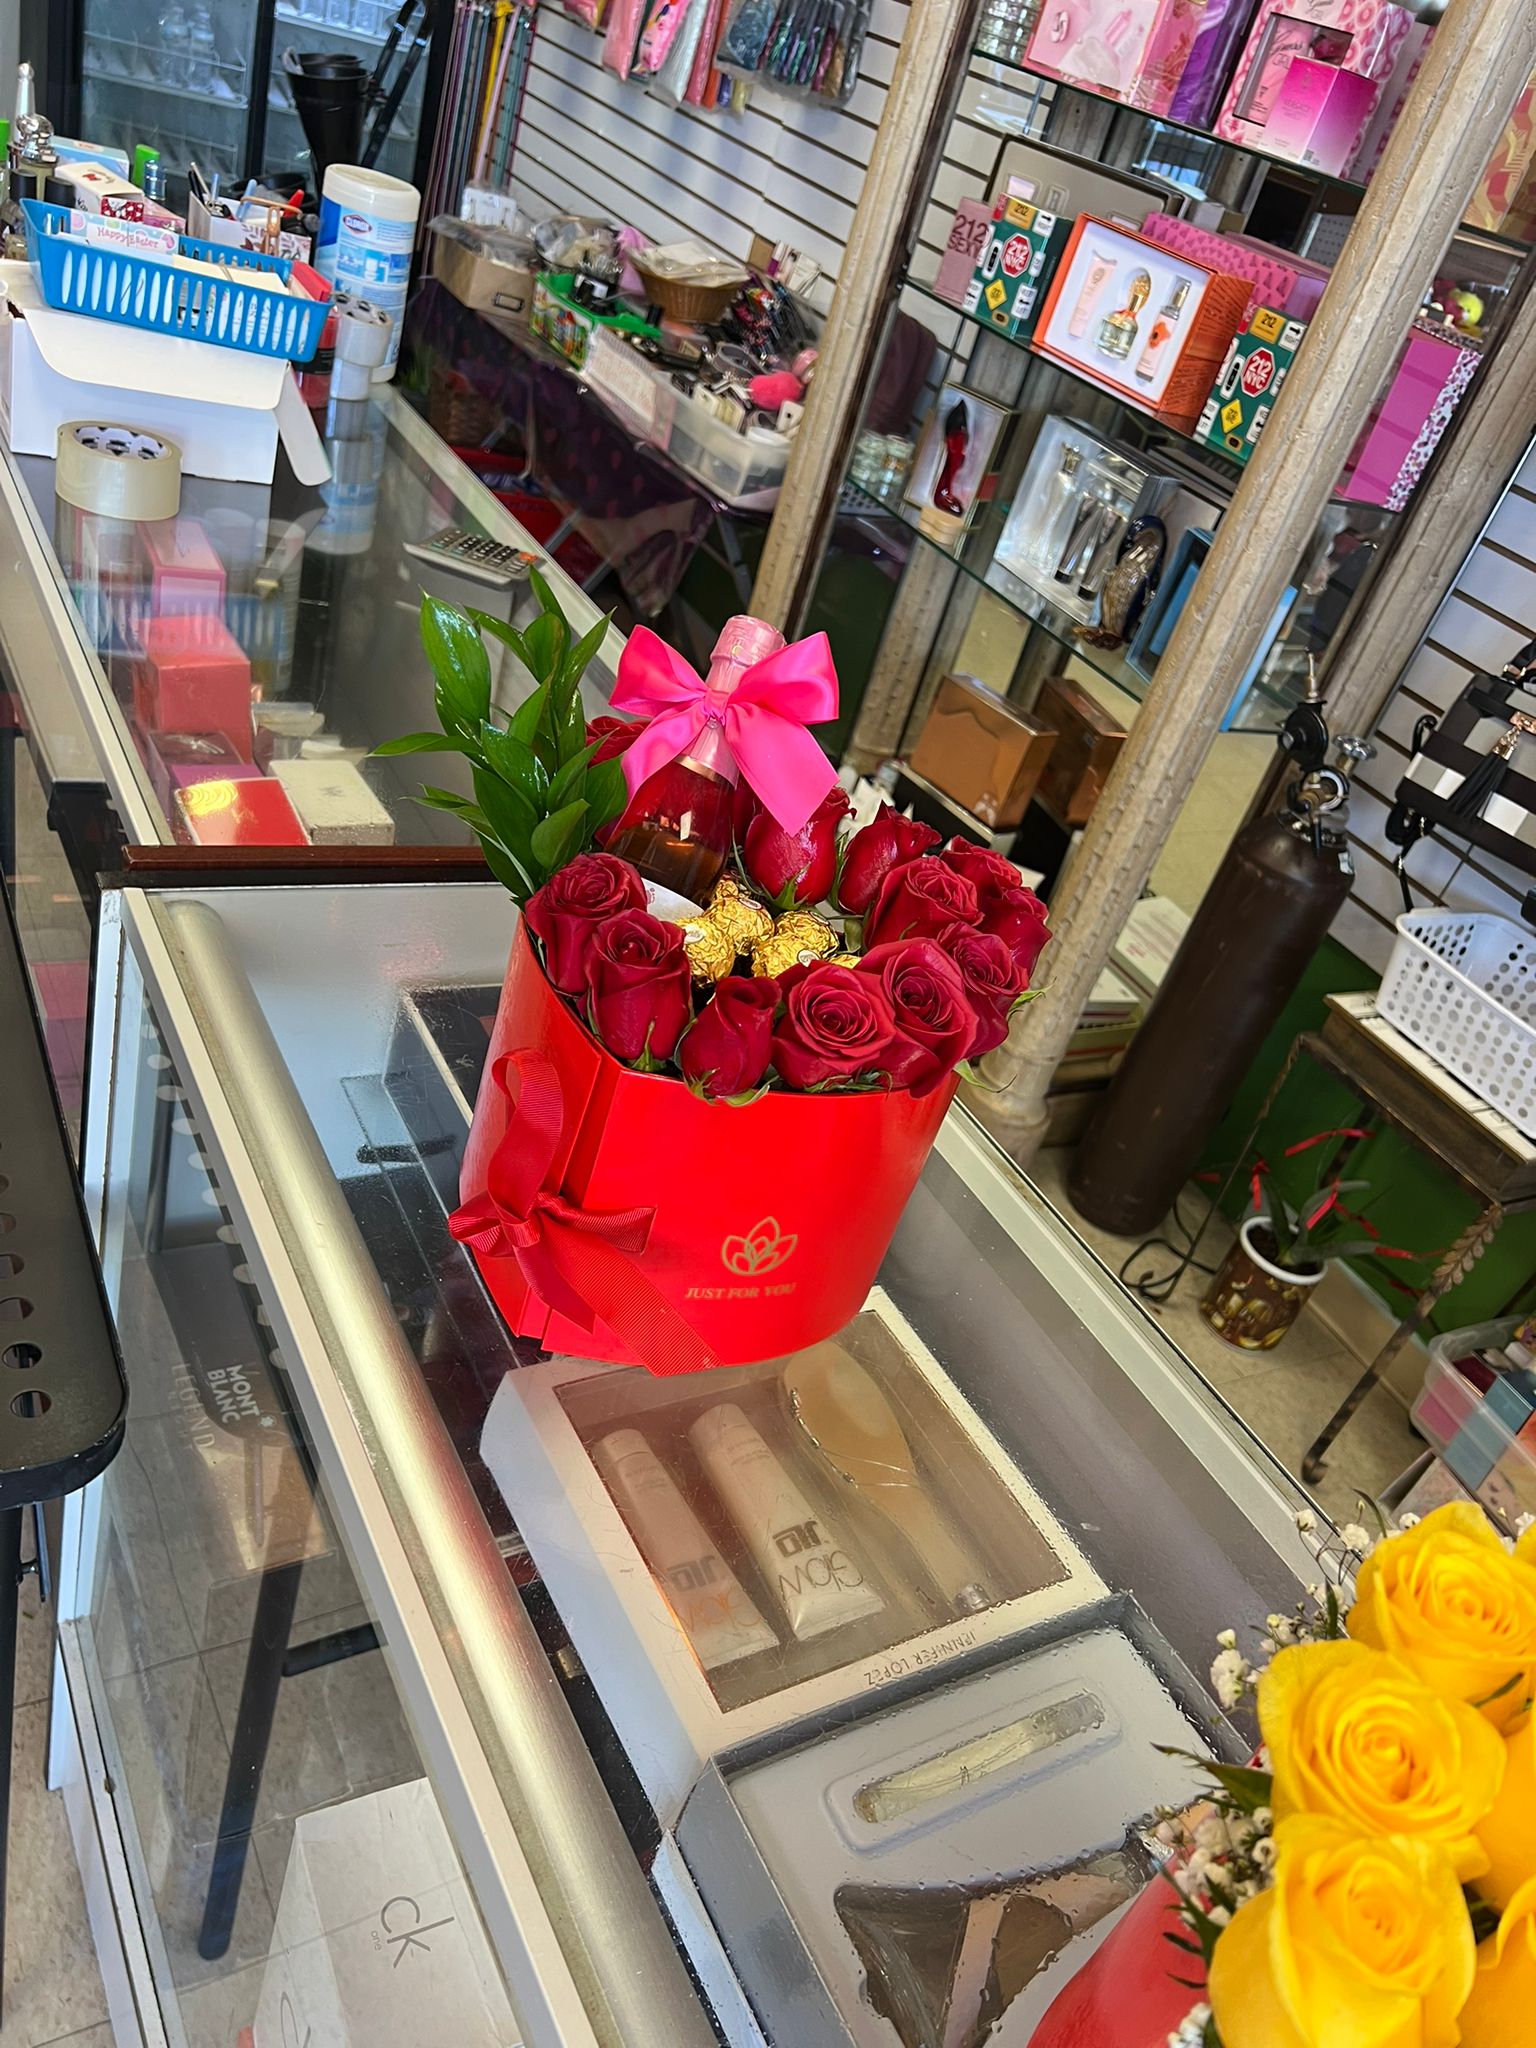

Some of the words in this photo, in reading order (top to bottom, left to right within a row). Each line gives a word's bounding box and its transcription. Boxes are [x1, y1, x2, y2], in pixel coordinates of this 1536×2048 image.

[952, 214, 990, 244] 212
[947, 234, 983, 259] SEXY
[1008, 240, 1029, 259] 212
[1261, 313, 1277, 328] 212
[1249, 355, 1272, 379] 212
[1244, 371, 1266, 390] NYC
[685, 1287, 726, 1299] JUST
[727, 1287, 760, 1300] FOR
[764, 1282, 797, 1297] YOU
[207, 1368, 241, 1424] BLANC
[226, 1364, 260, 1417] MONT
[171, 1363, 216, 1448] LEGEND
[912, 1630, 977, 1665] JENNIFER
[863, 1657, 911, 1686] LOPEZ
[370, 1929, 383, 1952] one
